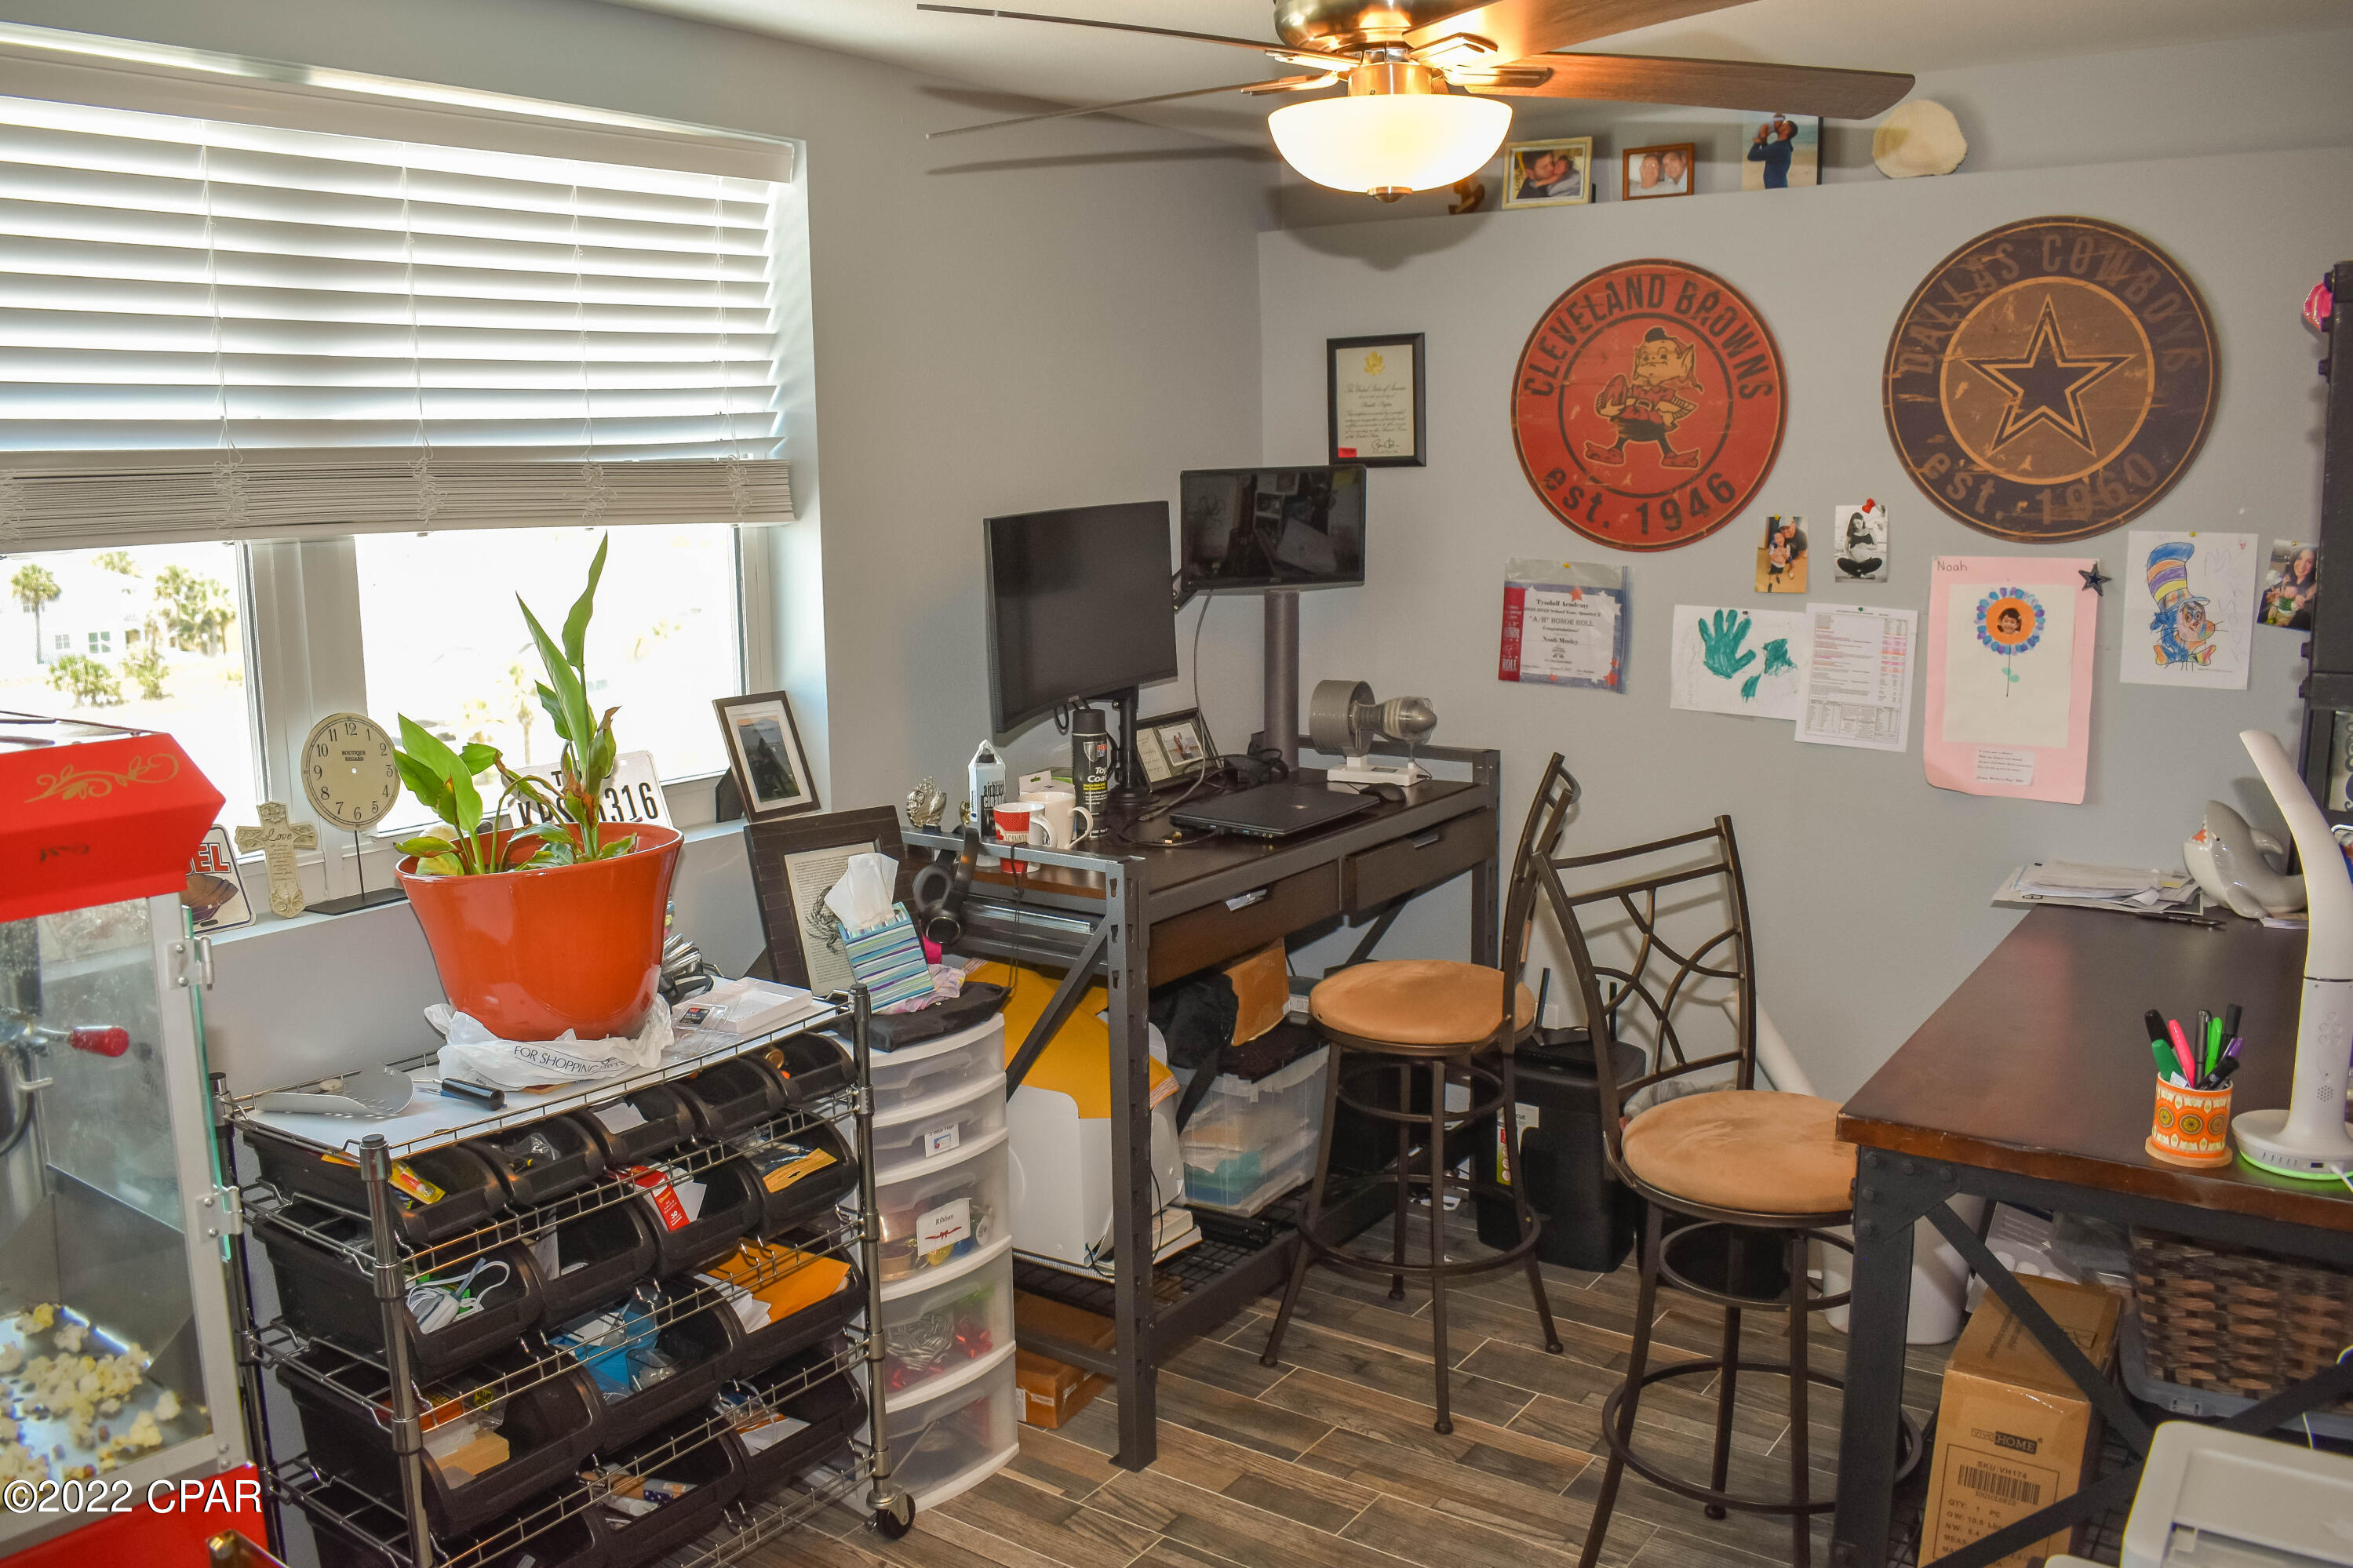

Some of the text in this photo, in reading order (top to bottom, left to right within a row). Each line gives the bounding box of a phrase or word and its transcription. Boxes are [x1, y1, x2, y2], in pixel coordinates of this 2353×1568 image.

[1898, 234, 2204, 376] DALLAS COWBOYS
[1524, 275, 1773, 400] CLEVELAND BROWNS
[2036, 453, 2159, 524] 1960
[1543, 467, 1736, 535] est. 1946
[1937, 560, 1968, 571] Noah
[1551, 617, 1574, 626] HONOR
[329, 729, 338, 741] 11
[344, 722, 358, 736] 12
[366, 729, 371, 740] 1
[317, 744, 328, 757] 10
[380, 742, 388, 756] 2
[314, 765, 322, 780] 9
[385, 764, 393, 777] 3
[321, 786, 330, 800] 8
[382, 784, 389, 797] 4
[336, 801, 344, 814] 7
[354, 806, 362, 820] 6
[371, 800, 379, 813] 5
[263, 829, 292, 841] Love
[1007, 834, 1028, 844] CANADA
[181, 842, 231, 875] EL
[514, 1046, 537, 1065] FOR
[671, 1210, 679, 1220] 30
[935, 1213, 954, 1225] Ribbon
